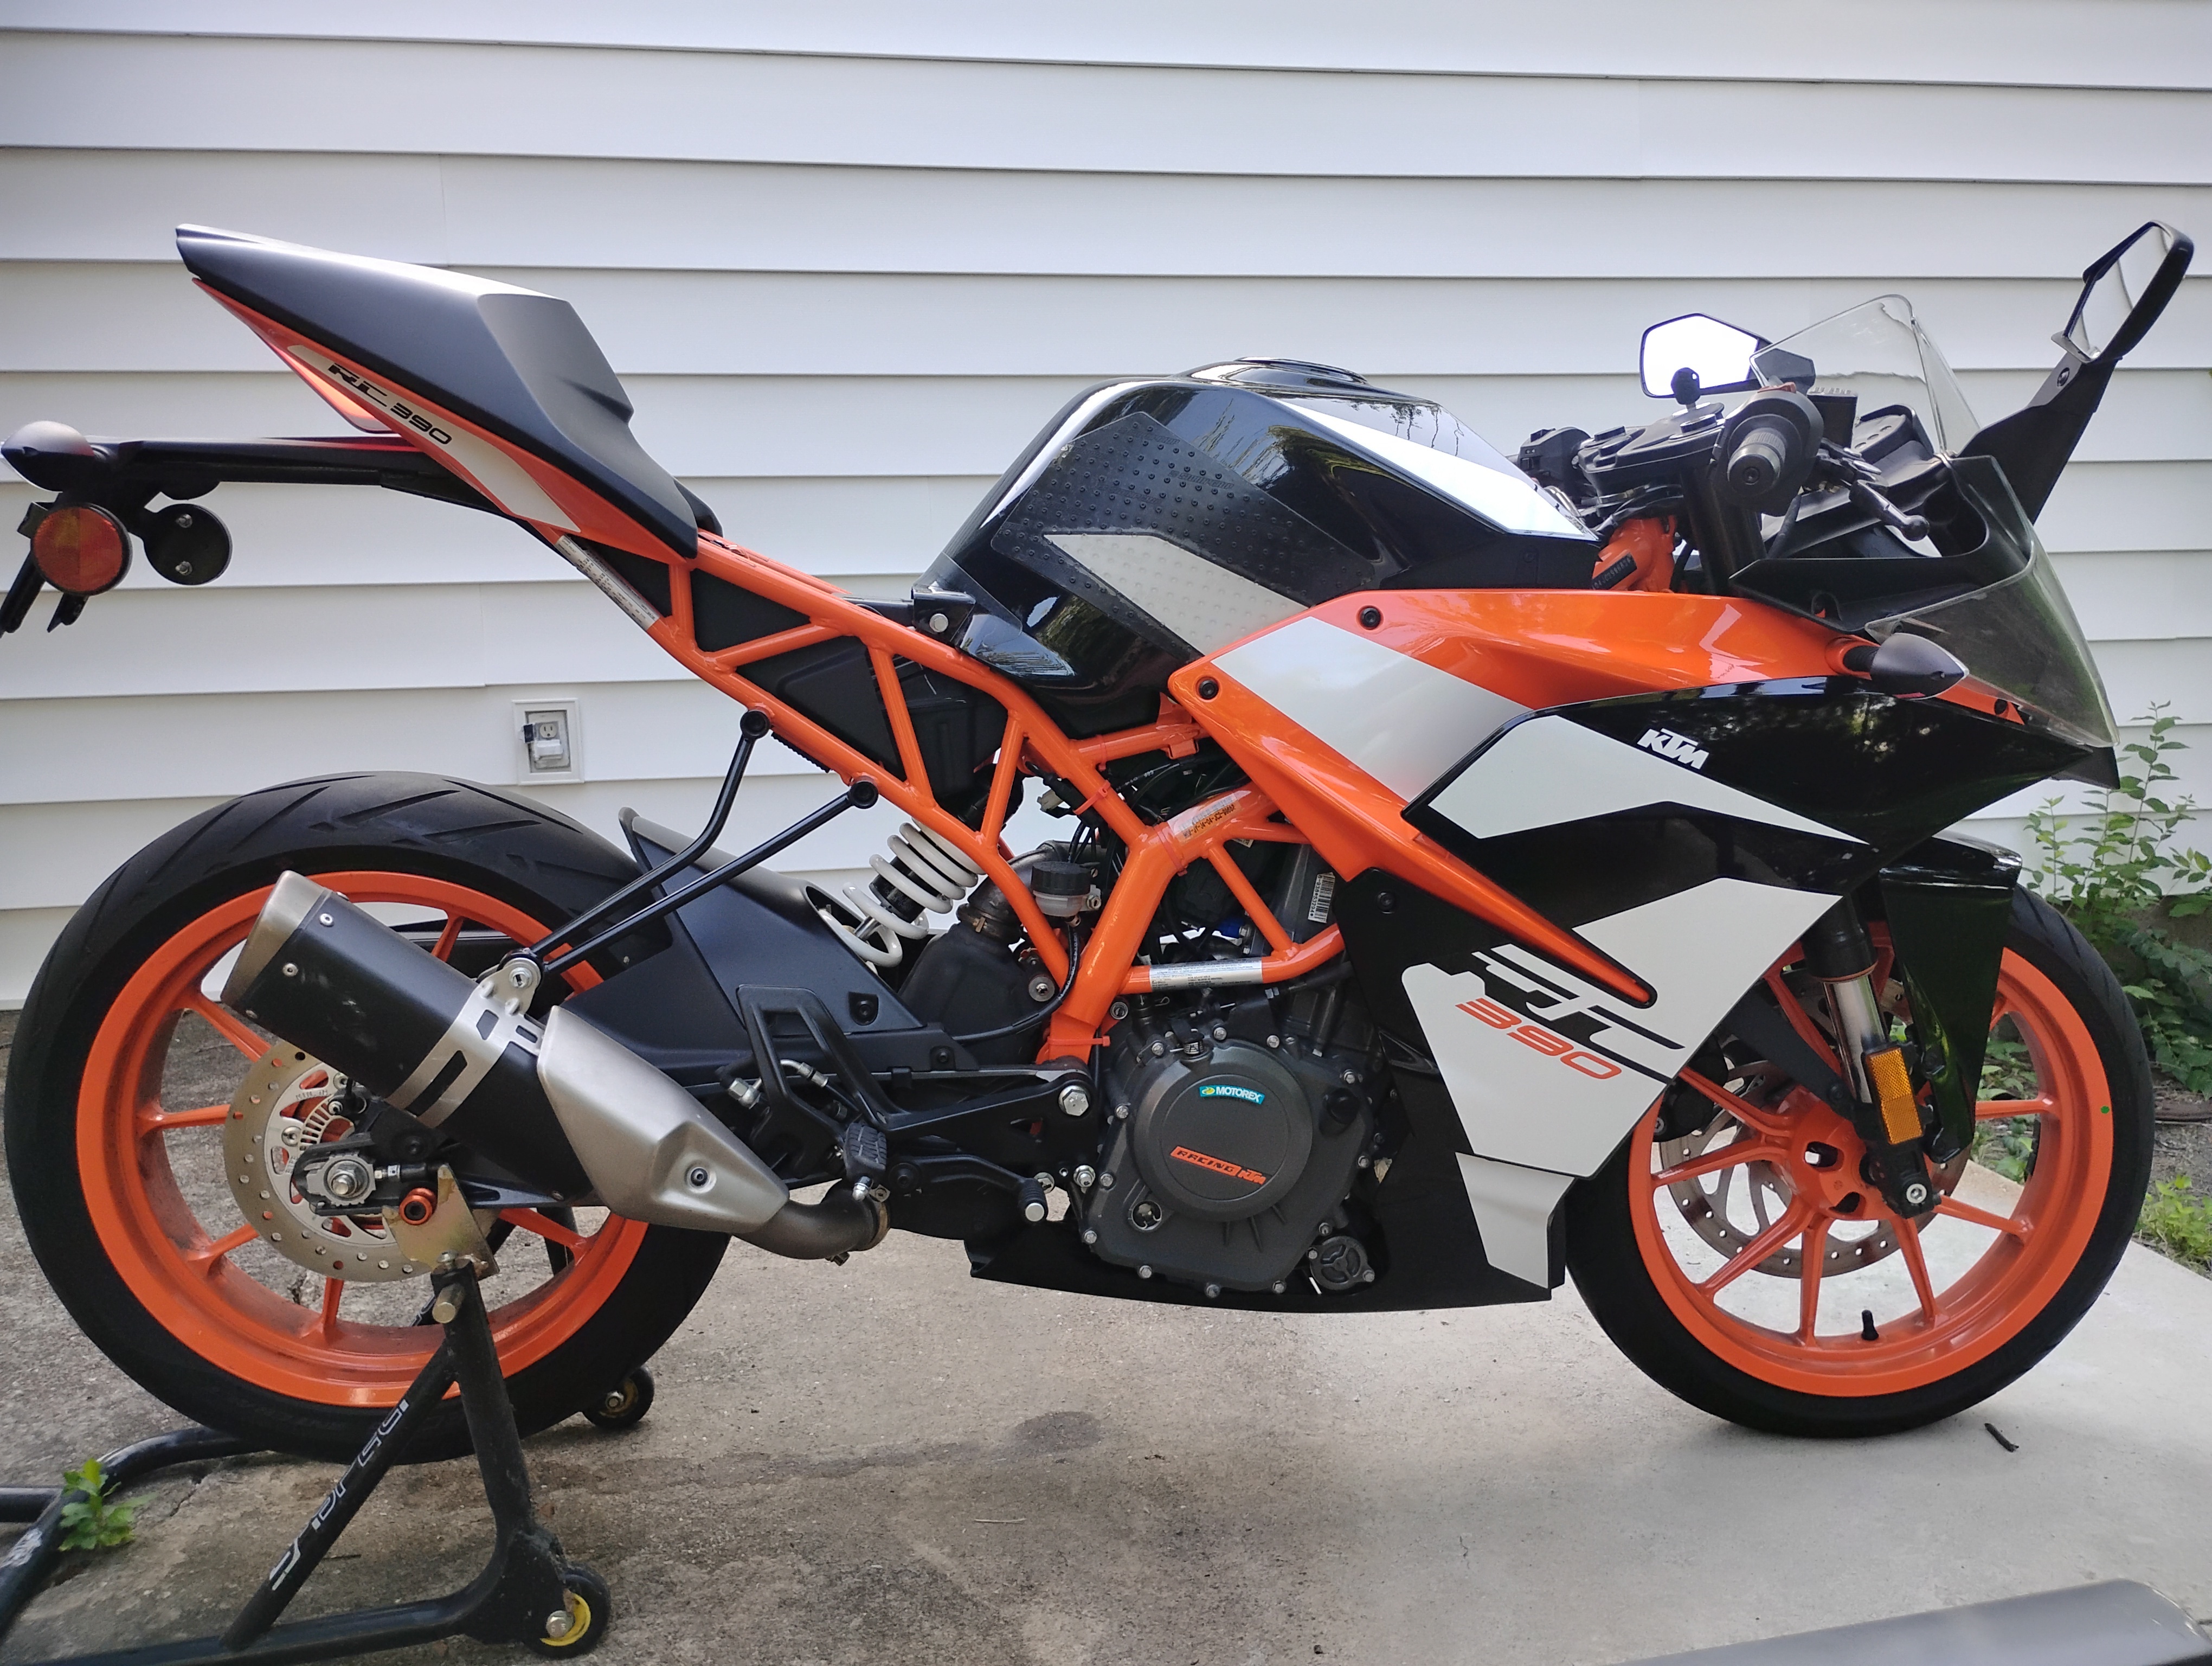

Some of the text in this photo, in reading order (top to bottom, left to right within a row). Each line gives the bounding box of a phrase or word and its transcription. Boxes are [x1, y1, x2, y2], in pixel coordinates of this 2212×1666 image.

[328, 362, 452, 445] RC 390
[1637, 727, 1709, 770] KTM
[1452, 945, 1685, 1084] RC
[1455, 997, 1622, 1080] 390
[1216, 1086, 1263, 1103] MOTOREX
[1176, 1150, 1266, 1185] RACING KTM
